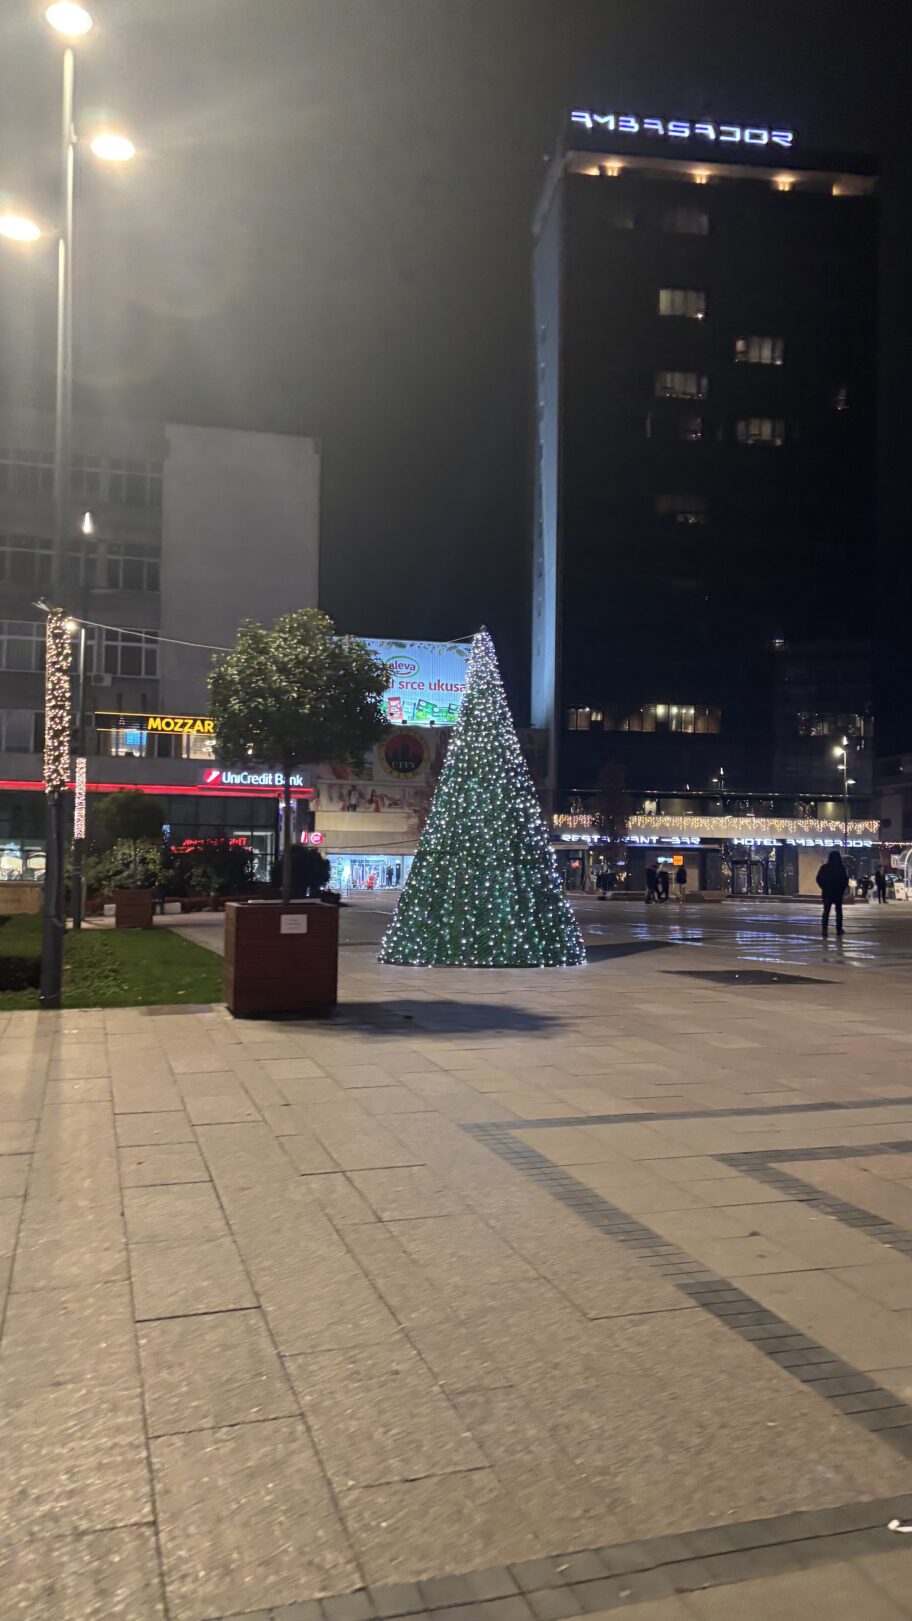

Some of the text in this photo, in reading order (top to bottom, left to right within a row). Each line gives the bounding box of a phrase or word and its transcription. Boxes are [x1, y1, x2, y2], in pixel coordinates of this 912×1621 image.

[571, 110, 793, 147] AMBASADOR
[398, 680, 425, 690] srce
[147, 717, 216, 733] MOZZAR
[222, 771, 273, 785] UniCredit
[733, 838, 782, 846] HOTEL
